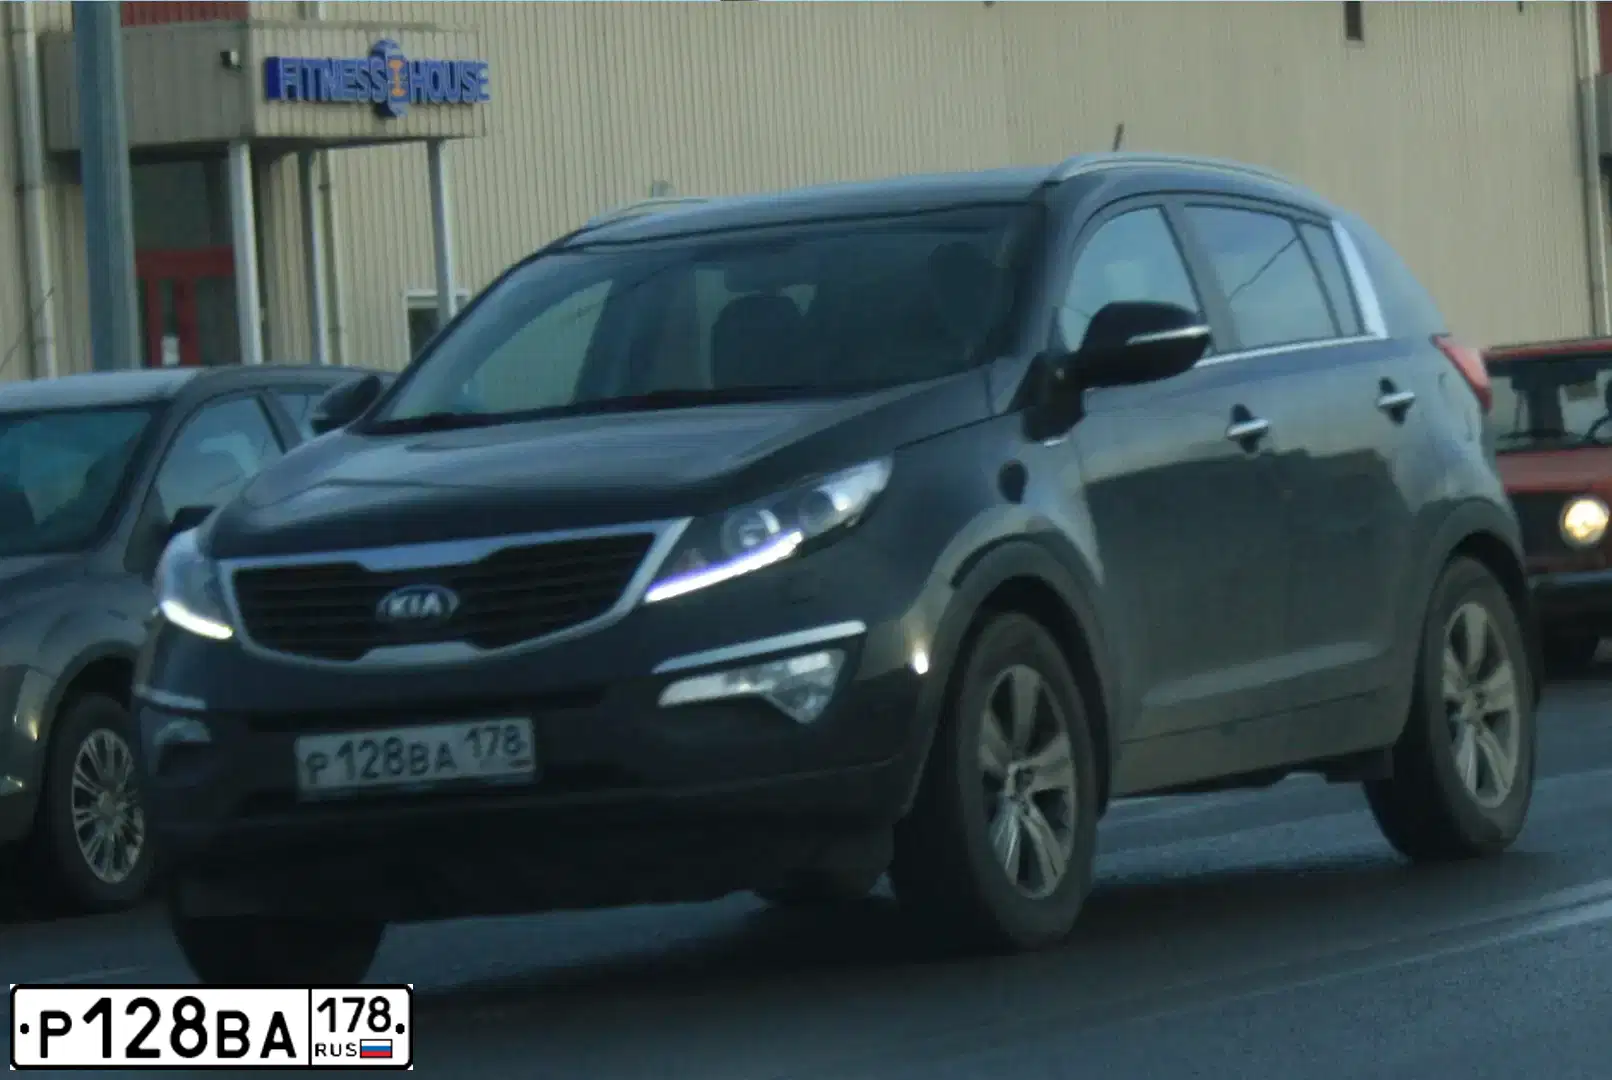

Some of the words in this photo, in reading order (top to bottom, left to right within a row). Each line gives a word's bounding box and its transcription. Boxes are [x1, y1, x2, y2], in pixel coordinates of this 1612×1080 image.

[279, 57, 386, 103] FITNESS
[408, 60, 489, 104] HOUSE
[389, 592, 443, 618] KIA
[306, 737, 457, 784] P128BA
[463, 725, 523, 758] 178
